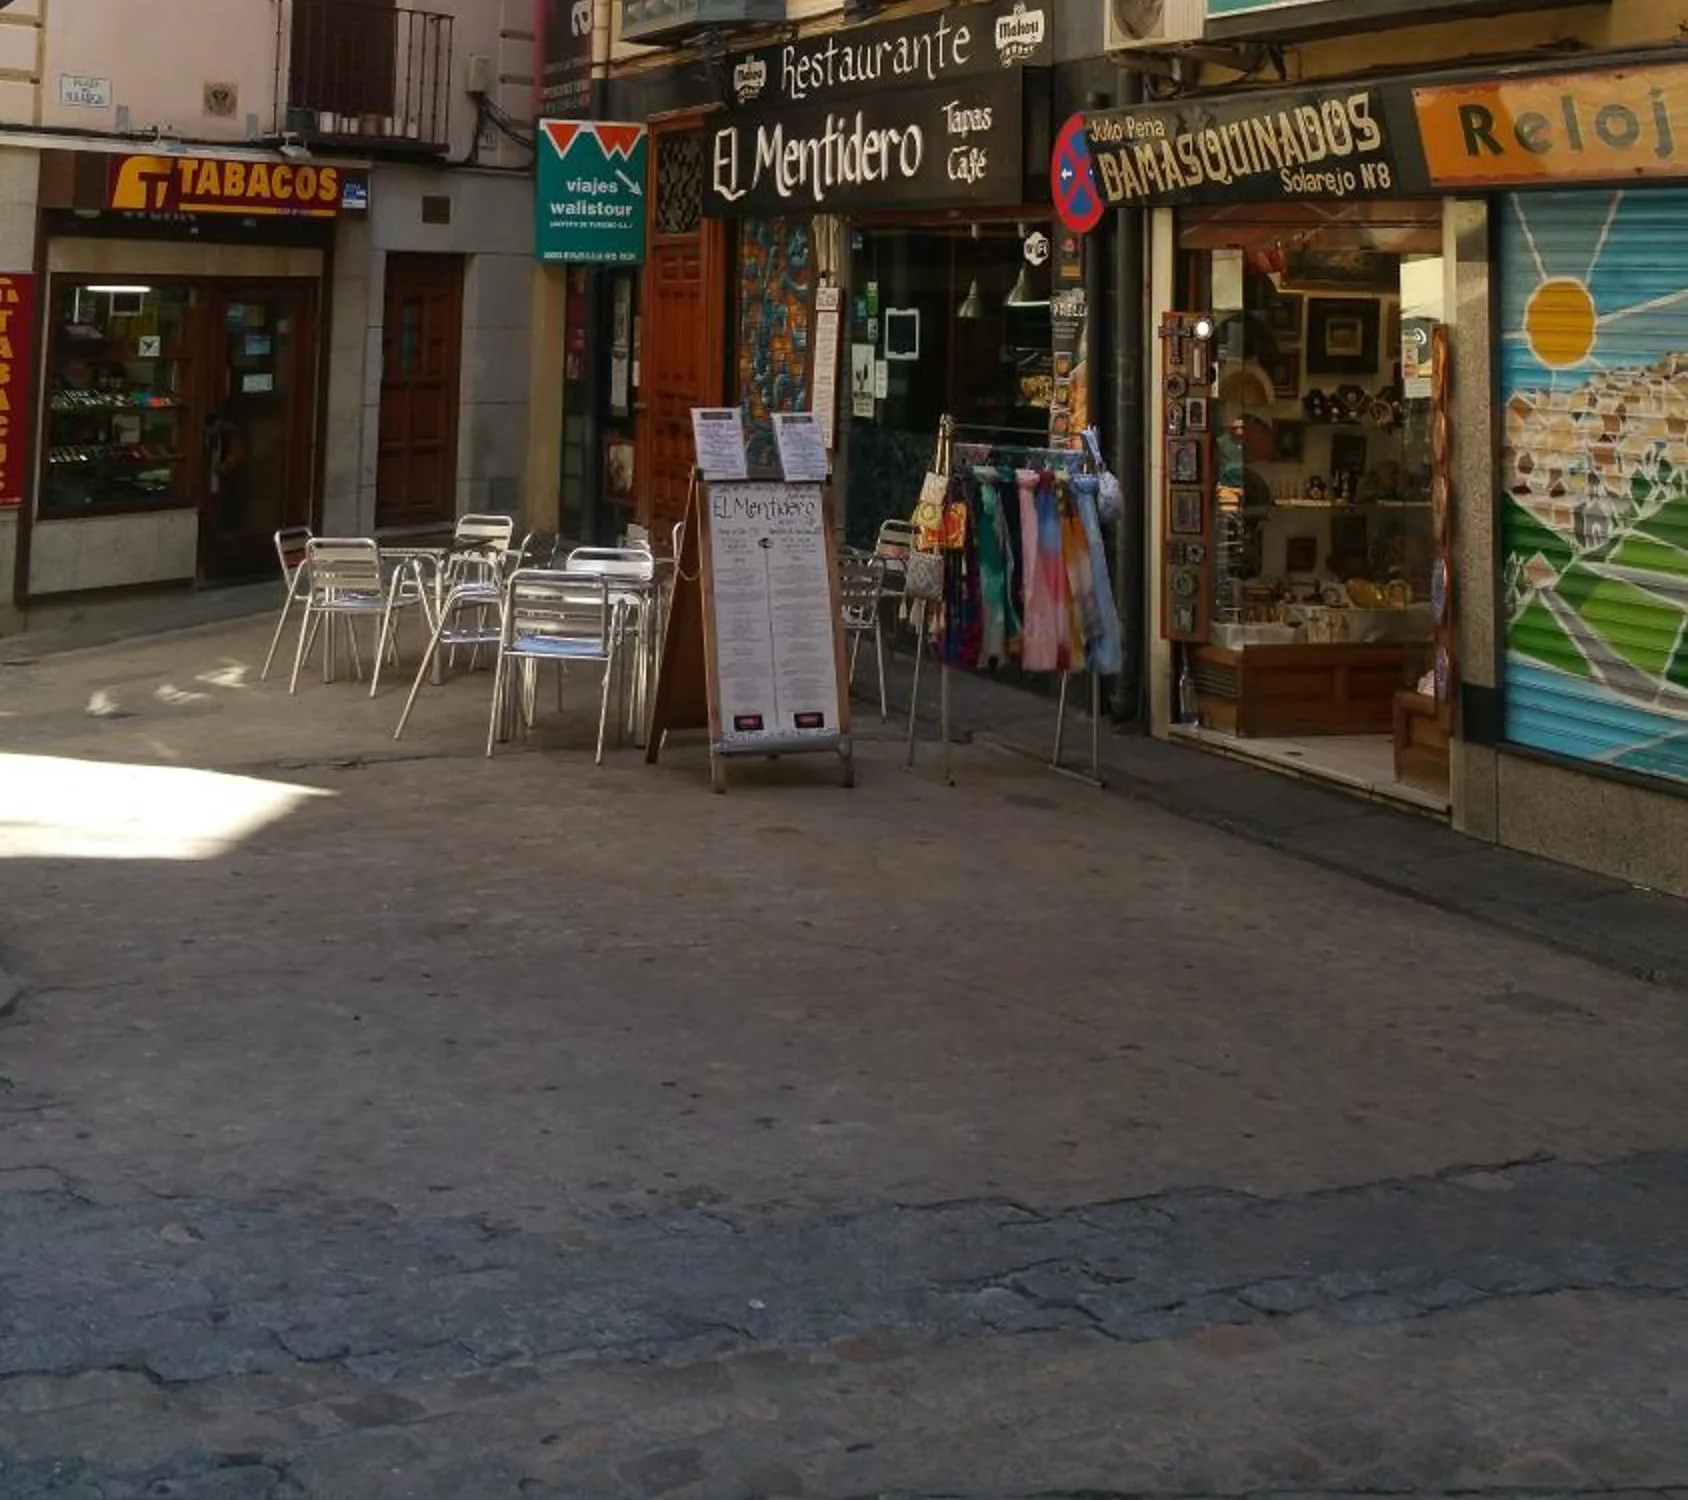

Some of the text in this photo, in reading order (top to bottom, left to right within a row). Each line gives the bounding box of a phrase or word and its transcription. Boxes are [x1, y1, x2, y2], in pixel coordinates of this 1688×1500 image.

[1000, 19, 1039, 40] Mahou
[781, 14, 972, 100] Restaurante
[941, 100, 993, 138] Tapas
[1089, 117, 1123, 143] Julio
[1457, 86, 1675, 158] Reloj
[751, 110, 924, 201] Mentidero
[946, 145, 989, 184] Café
[1097, 91, 1382, 202] DAMASQUINADOS
[176, 158, 338, 201] TABACOS
[566, 177, 619, 197] viajes
[1280, 166, 1356, 197] Solarejo
[550, 200, 633, 217] walistour
